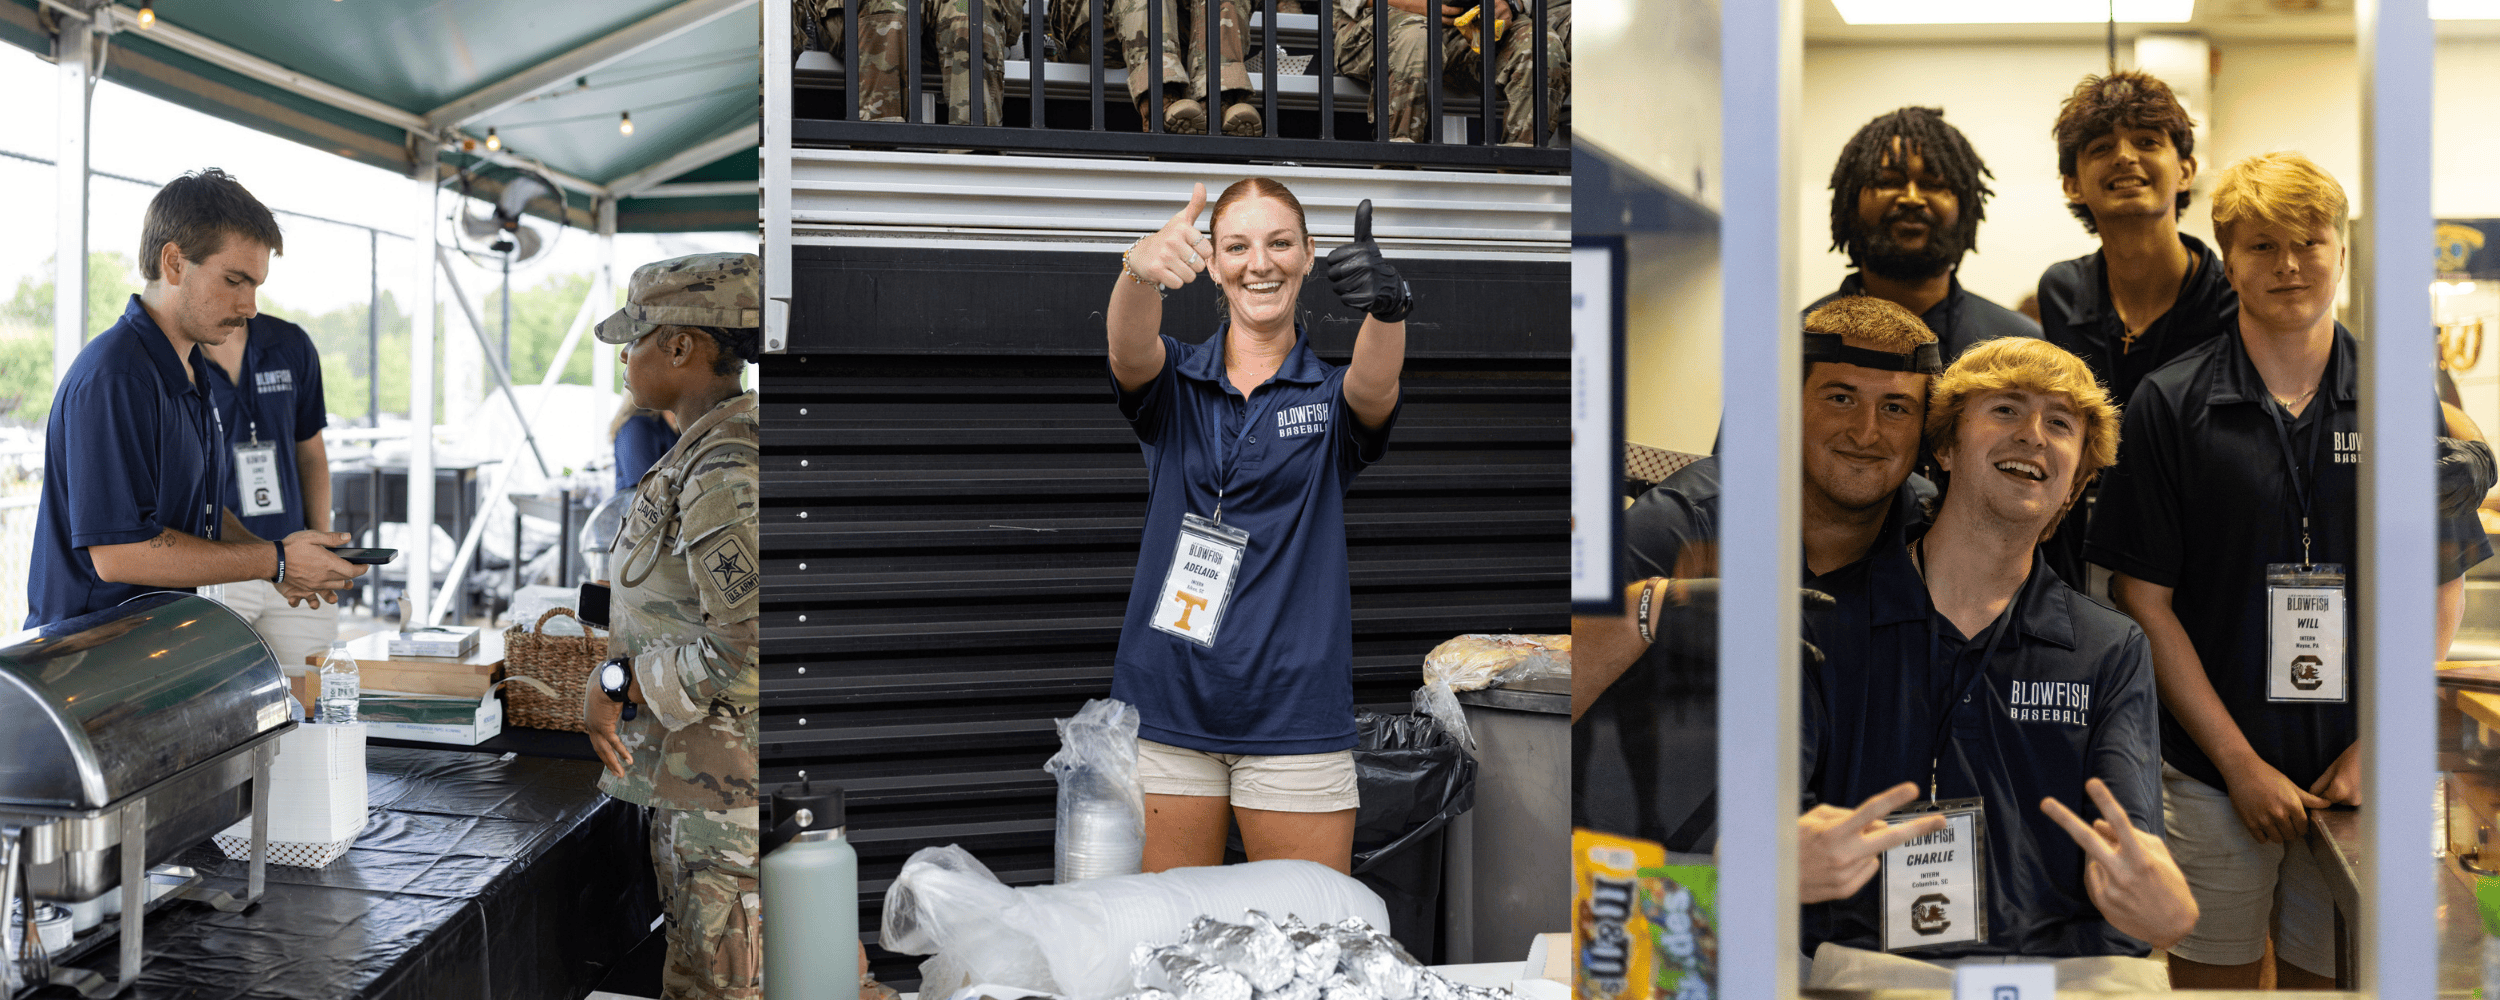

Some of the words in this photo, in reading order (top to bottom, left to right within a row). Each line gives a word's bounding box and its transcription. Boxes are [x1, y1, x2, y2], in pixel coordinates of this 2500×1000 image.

[1277, 403, 1329, 427] BLOWFISH
[637, 500, 658, 524] DAVIS
[1189, 543, 1224, 565] BLOWFISH
[1183, 561, 1220, 580] ADELAIDE
[728, 589, 742, 601] U.S.
[740, 575, 759, 594] ARMY
[1639, 588, 1651, 619] COCK
[2287, 597, 2329, 612] BLOWFISH
[2297, 618, 2319, 629] WILL
[2010, 680, 2090, 711] BLOWFISH
[2010, 707, 2088, 726] BASEBALL
[1906, 850, 1954, 867] CHARLIE
[1911, 880, 1939, 888] Columbia,
[1920, 871, 1940, 879] INTERN
